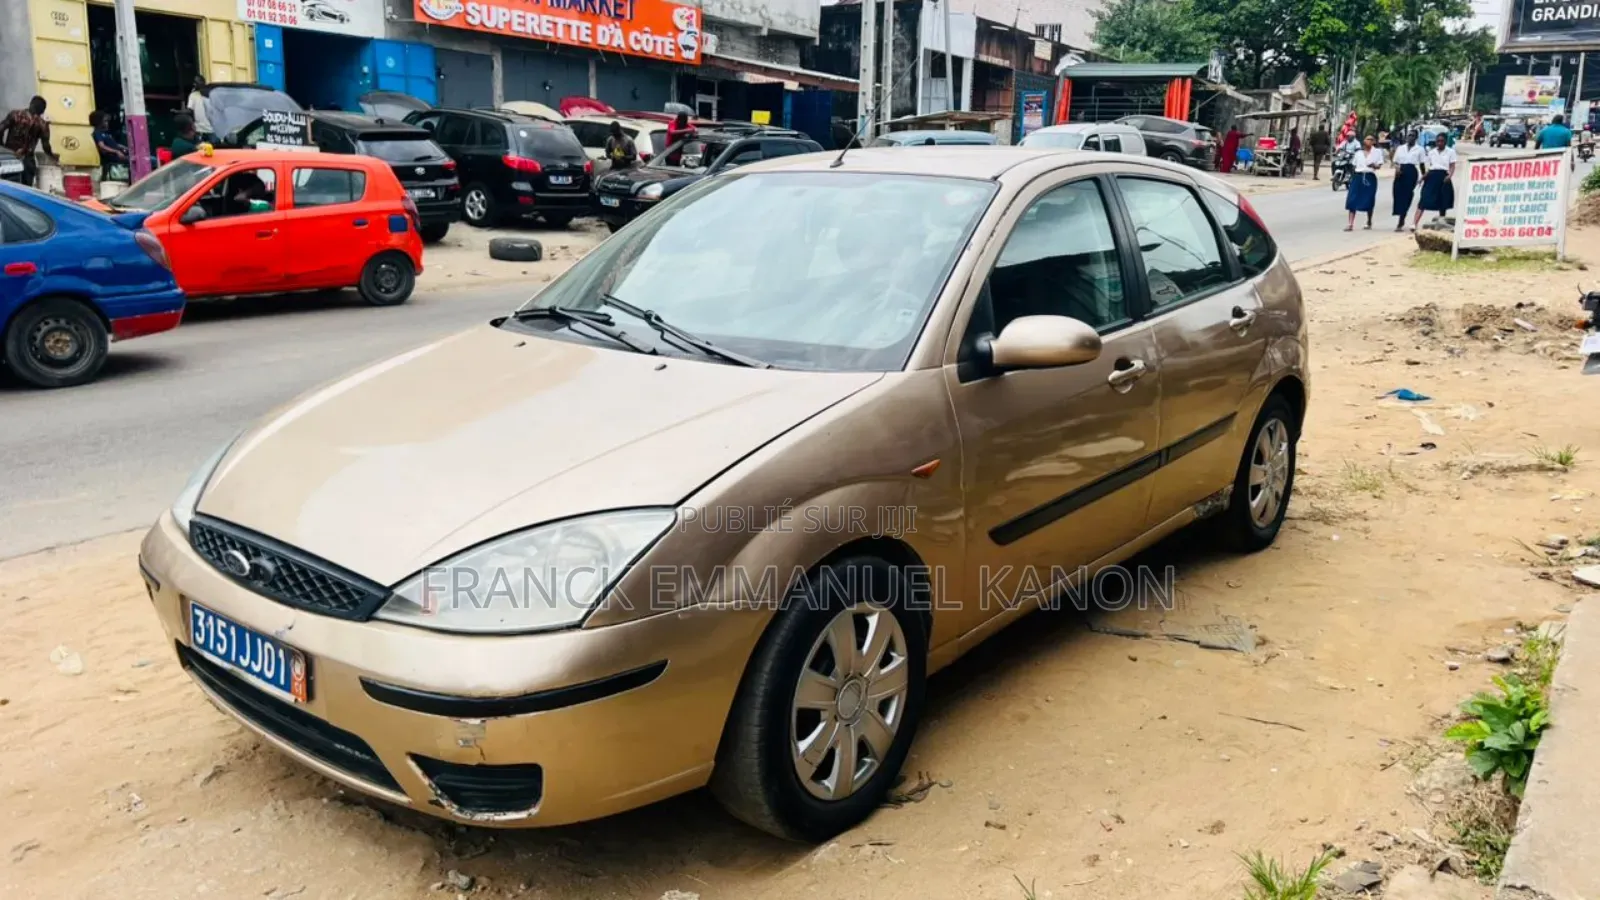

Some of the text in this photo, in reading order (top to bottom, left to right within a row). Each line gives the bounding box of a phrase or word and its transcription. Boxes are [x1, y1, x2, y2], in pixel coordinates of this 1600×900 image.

[1532, 4, 1600, 22] GRANDI
[465, 2, 592, 44] SUPERETTE
[629, 26, 676, 57] CÔTÉ
[1471, 160, 1561, 181] RESTAURANT
[1528, 180, 1555, 190] Marie
[193, 607, 286, 687] 3151JJ01
